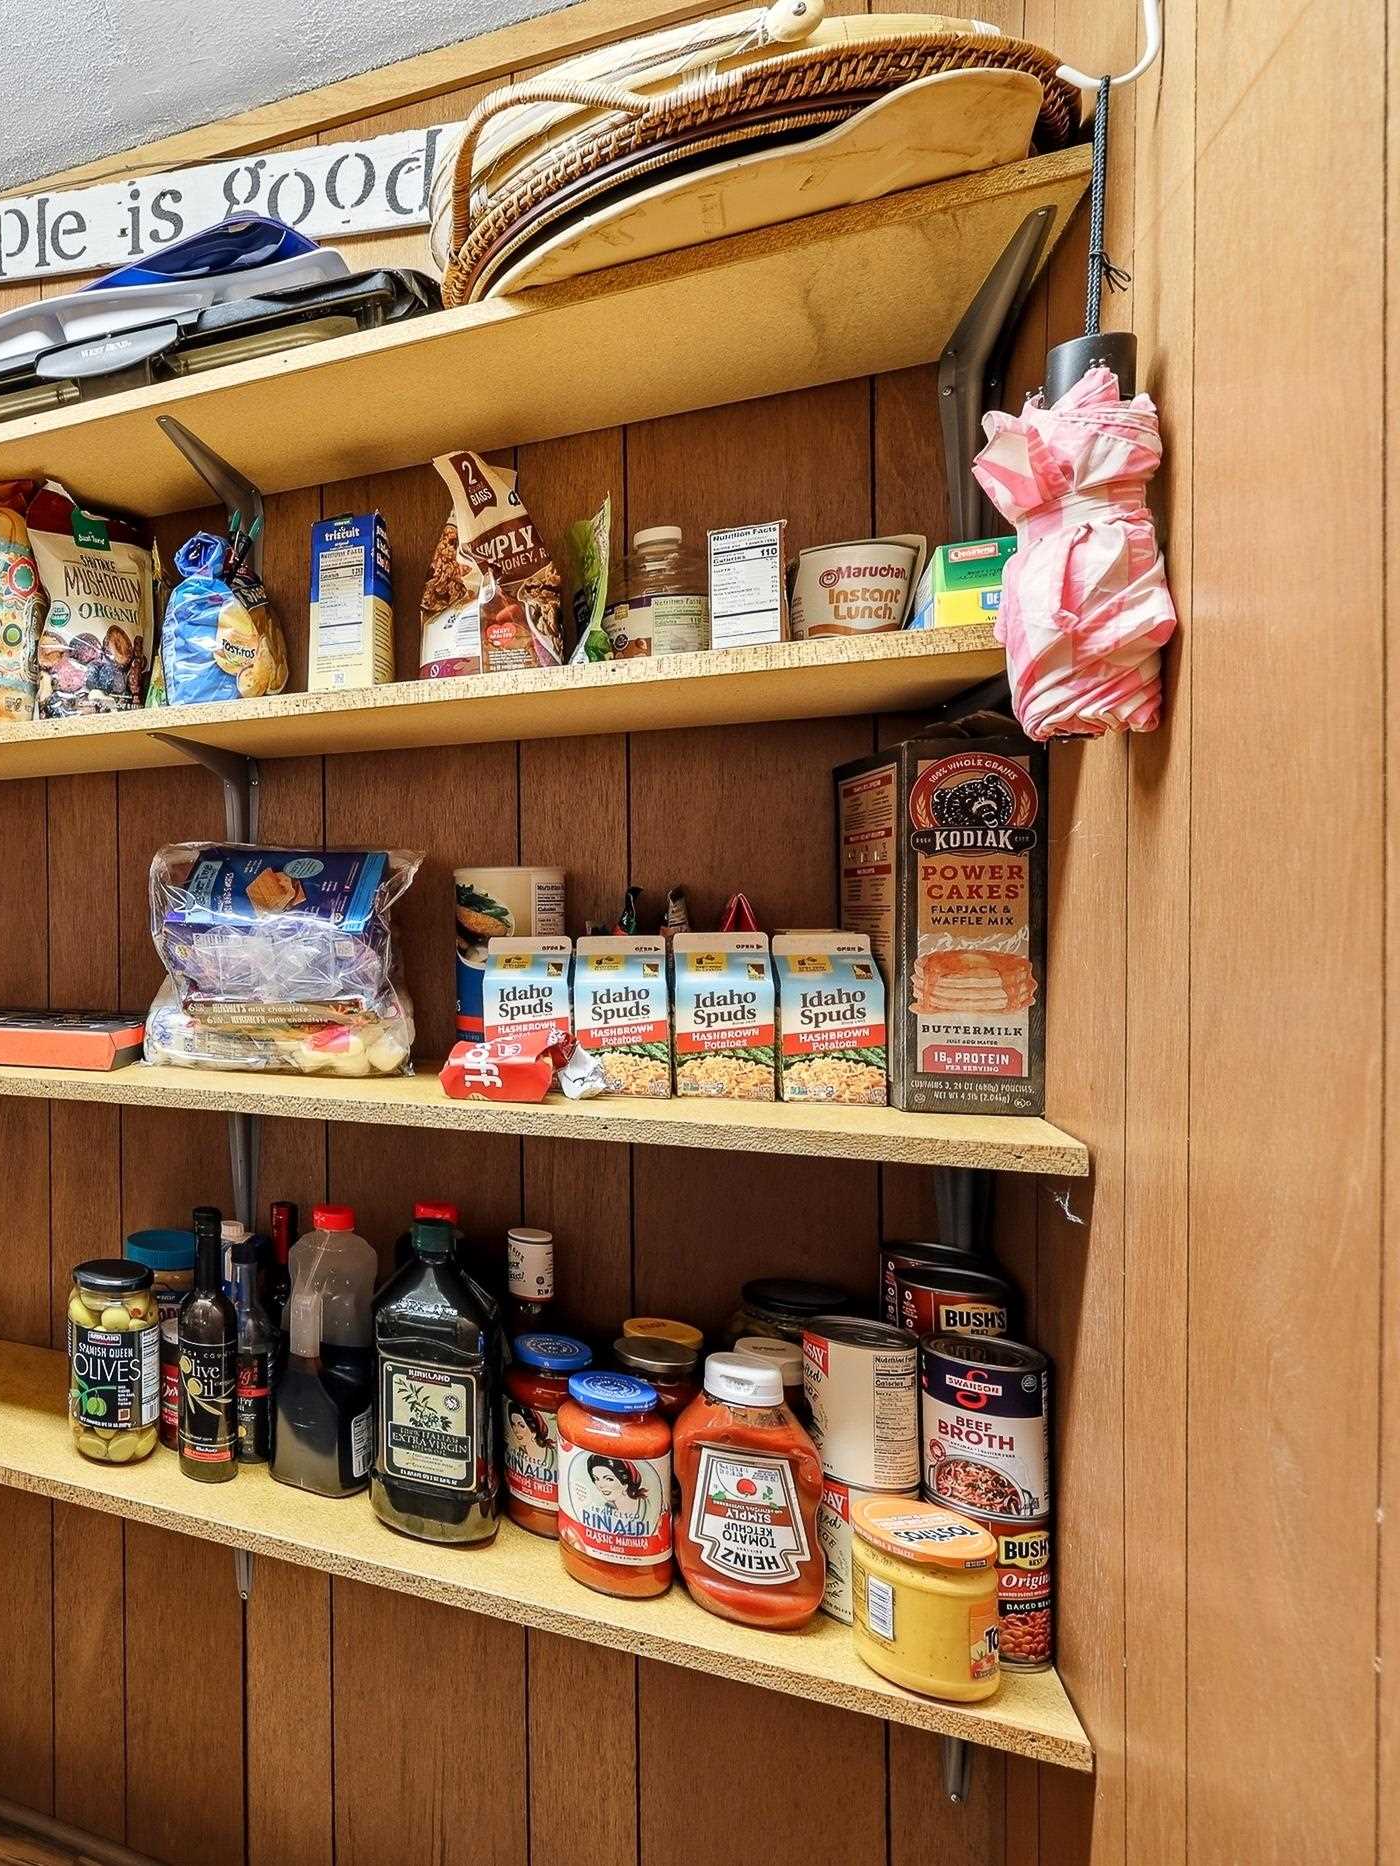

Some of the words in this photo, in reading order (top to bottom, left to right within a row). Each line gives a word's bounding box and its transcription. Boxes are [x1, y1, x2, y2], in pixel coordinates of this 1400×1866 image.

[127, 180, 184, 256] is
[223, 129, 442, 227] good
[461, 460, 477, 485] 2
[470, 488, 492, 506] BAGS
[325, 526, 360, 542] triscuit
[712, 530, 751, 543] Nutrition
[752, 526, 777, 536] Facts
[713, 555, 746, 565] Calories
[760, 547, 777, 557] 110
[836, 564, 906, 580] Maruchan
[64, 565, 141, 606] MUSHROOM
[828, 588, 900, 605] Instant
[78, 601, 140, 625] ORGANIC
[832, 603, 896, 621] Lunch.
[929, 767, 948, 783] 100%
[948, 759, 983, 772] WHOLE
[984, 759, 1018, 781] GRAINS
[935, 829, 1014, 850] KODIAK
[922, 864, 1025, 881] POWER
[926, 884, 1021, 900] CAKES
[931, 904, 997, 914] FLAPJACK
[1003, 906, 1011, 914] &
[931, 916, 985, 926] WAFFLE
[987, 917, 1014, 926] MIX
[499, 984, 553, 1002] Idaho
[592, 986, 650, 1006] Idaho
[693, 989, 757, 1009] Idaho
[800, 988, 866, 1009] Idaho
[499, 998, 553, 1021] Spuds
[591, 1002, 650, 1024] Spuds
[693, 1005, 757, 1028] Spuds
[800, 1003, 867, 1028] Spuds
[590, 1025, 654, 1037] HASHBROWN
[691, 1027, 760, 1041] HASHBROWN
[799, 1028, 870, 1043] HASHBROWN
[921, 1024, 1023, 1036] BUTTERMILK
[602, 1034, 642, 1046] Potatoes
[704, 1039, 747, 1050] Potatoes
[812, 1040, 857, 1051] Potatoes
[955, 1052, 1010, 1065] PROTEIN
[963, 1065, 1000, 1073] SERVING
[944, 1307, 1007, 1331] BUSH'S
[79, 1342, 107, 1358] SPANISH
[108, 1346, 134, 1358] QUEEN
[74, 1352, 141, 1383] OLIVES
[408, 1368, 451, 1383] KIRKLAND
[875, 1379, 904, 1387] Calories
[947, 1376, 1000, 1395] SWANSON
[956, 1415, 992, 1432] BEEF
[393, 1431, 429, 1447] EXTRA
[428, 1439, 467, 1453] VIRGIN
[937, 1418, 1015, 1451] BROTH
[582, 1509, 650, 1536] RINALDI
[725, 1507, 772, 1524] SIMPLY
[585, 1528, 614, 1545] CLASSIC
[724, 1521, 773, 1537] KETCHUP
[722, 1530, 776, 1548] TOMATO
[720, 1547, 780, 1570] HEINZ
[1001, 1572, 1049, 1590] Origin
[1006, 1601, 1037, 1611] BAKED
